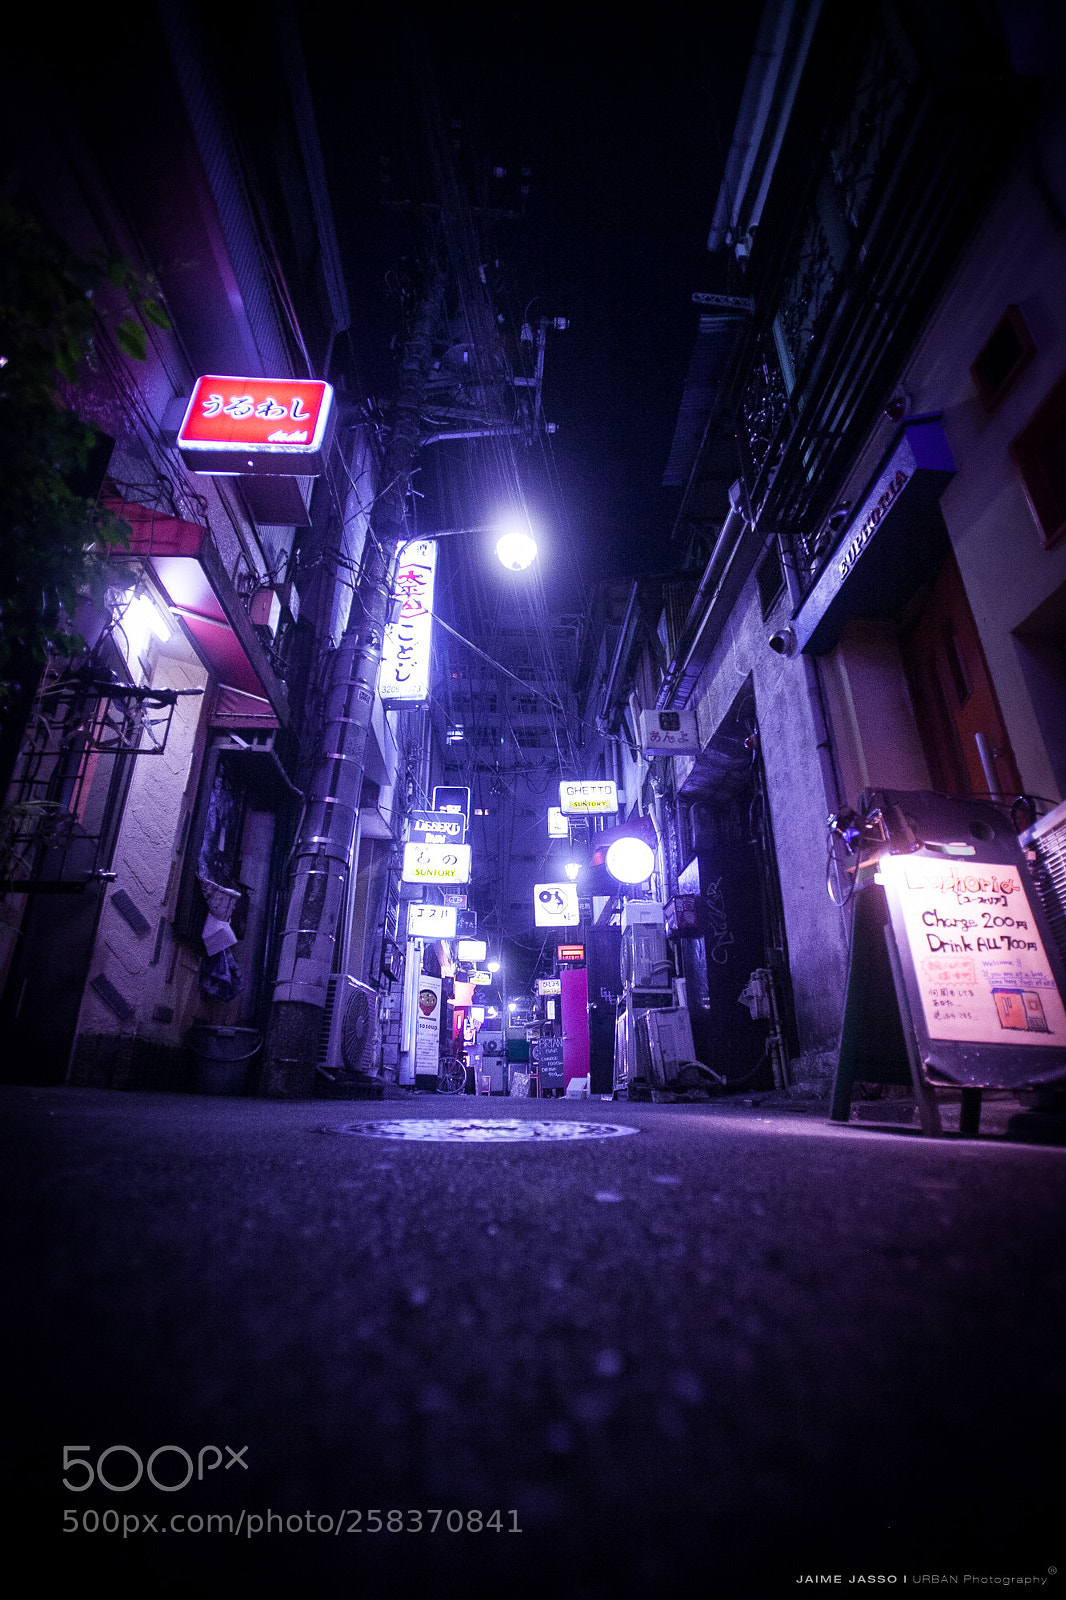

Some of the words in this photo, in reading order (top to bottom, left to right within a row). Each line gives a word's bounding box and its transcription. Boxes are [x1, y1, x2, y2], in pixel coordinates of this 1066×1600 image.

[202, 394, 310, 420] うるわし
[566, 786, 612, 796] GHETTO
[415, 868, 456, 877] SUNTORY
[922, 909, 978, 932] Charge
[981, 912, 1028, 931] 200円
[926, 933, 974, 953] Drink
